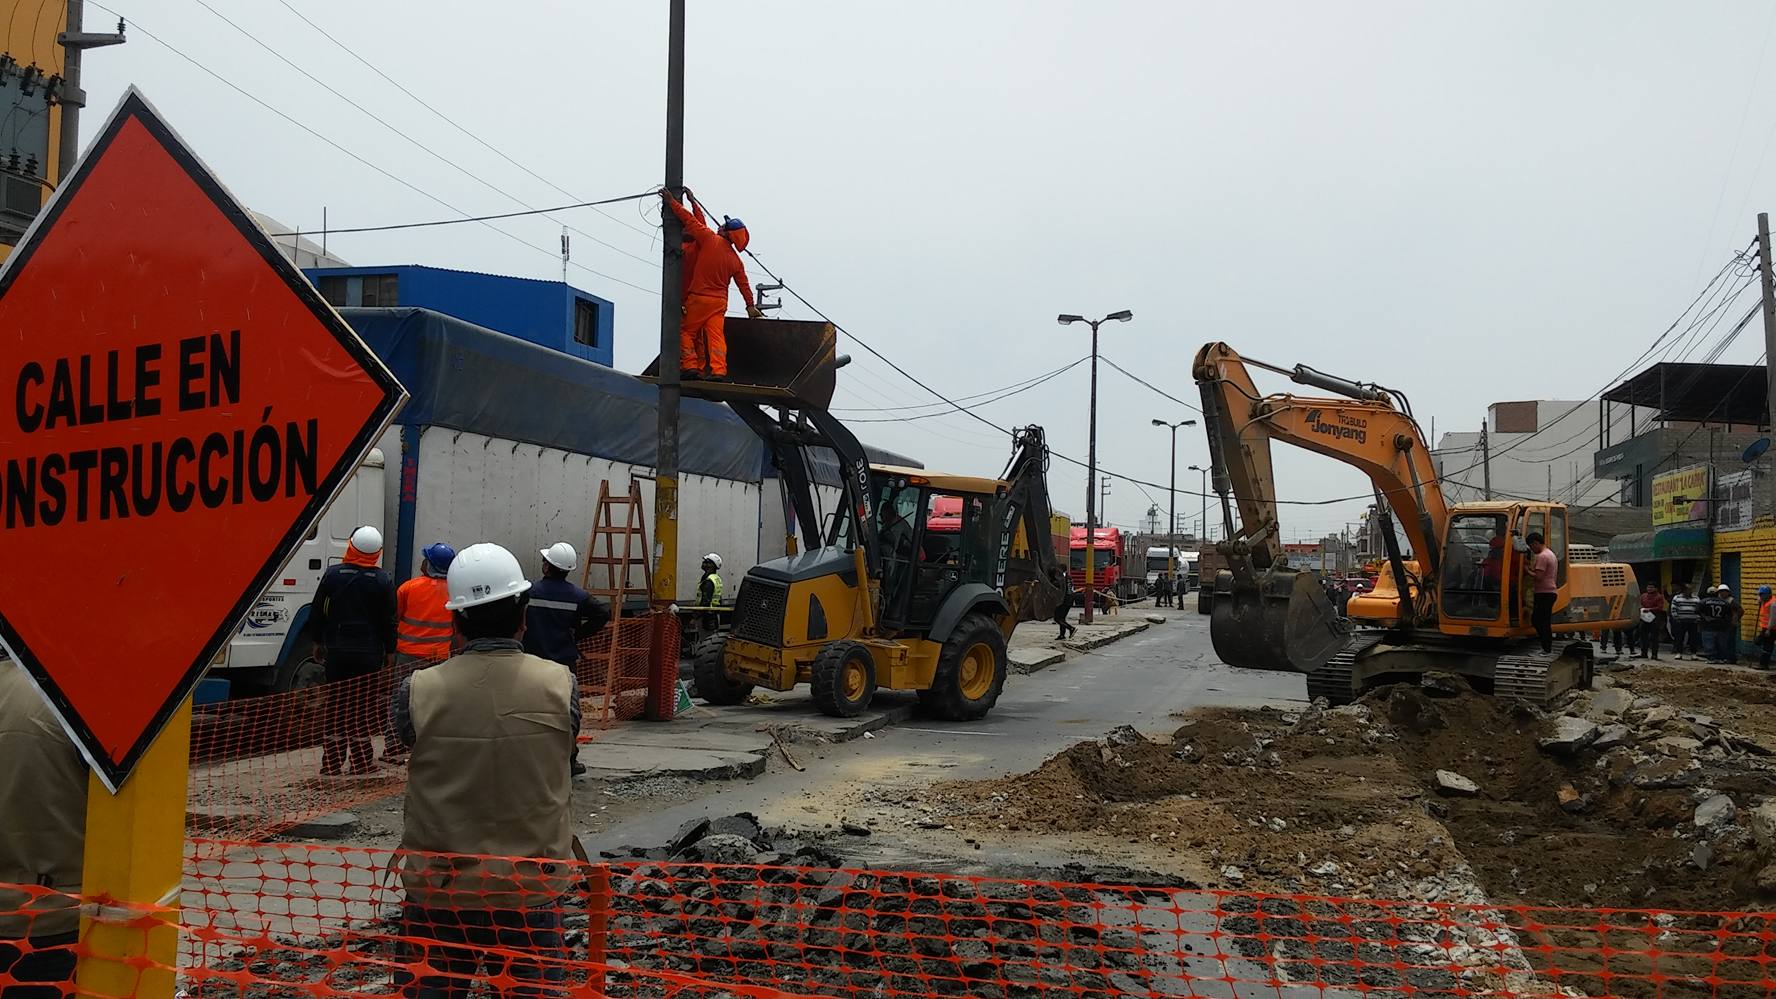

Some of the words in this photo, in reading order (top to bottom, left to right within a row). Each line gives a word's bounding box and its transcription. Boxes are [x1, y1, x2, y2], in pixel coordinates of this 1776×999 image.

[15, 342, 162, 433] CALLE
[178, 329, 241, 412] EN
[1311, 417, 1366, 444] Jonyang
[0, 406, 318, 529] NSTRUCCIÓN
[855, 458, 867, 490] 310J
[1710, 605, 1722, 617] 12
